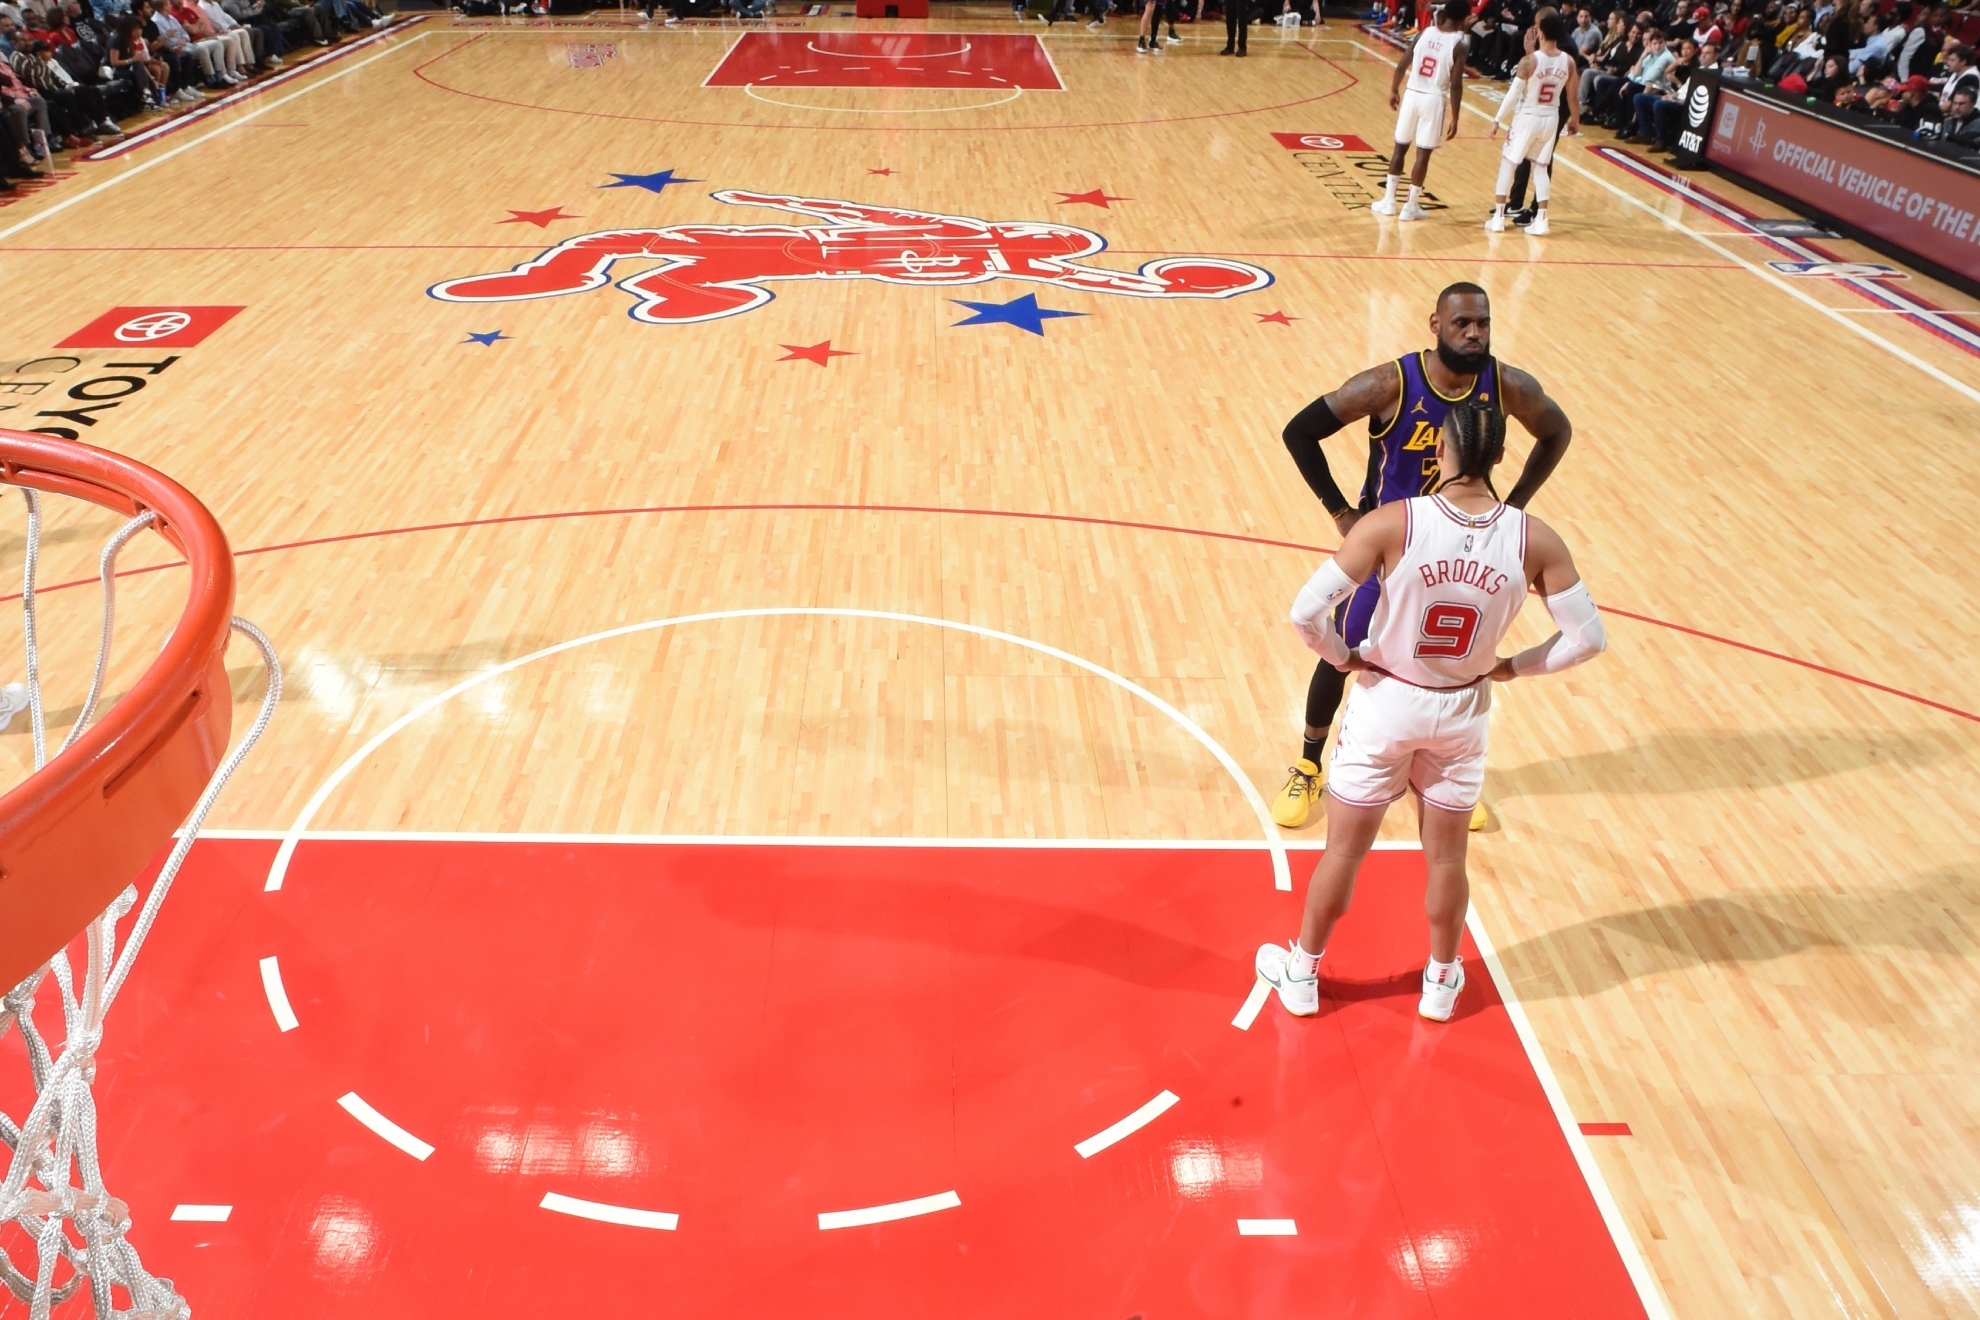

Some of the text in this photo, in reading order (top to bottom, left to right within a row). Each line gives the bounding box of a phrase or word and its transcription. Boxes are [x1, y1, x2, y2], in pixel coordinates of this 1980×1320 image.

[1419, 57, 1437, 77] 8
[1538, 84, 1556, 103] 5
[1678, 130, 1704, 154] AT&T
[1773, 139, 1836, 183] OFFICIAL
[1837, 163, 1908, 212] VEHICLE
[1905, 192, 1936, 222] OF
[1932, 202, 1975, 239] THE
[1419, 559, 1508, 595] BROOKS
[1413, 601, 1482, 659] 9
